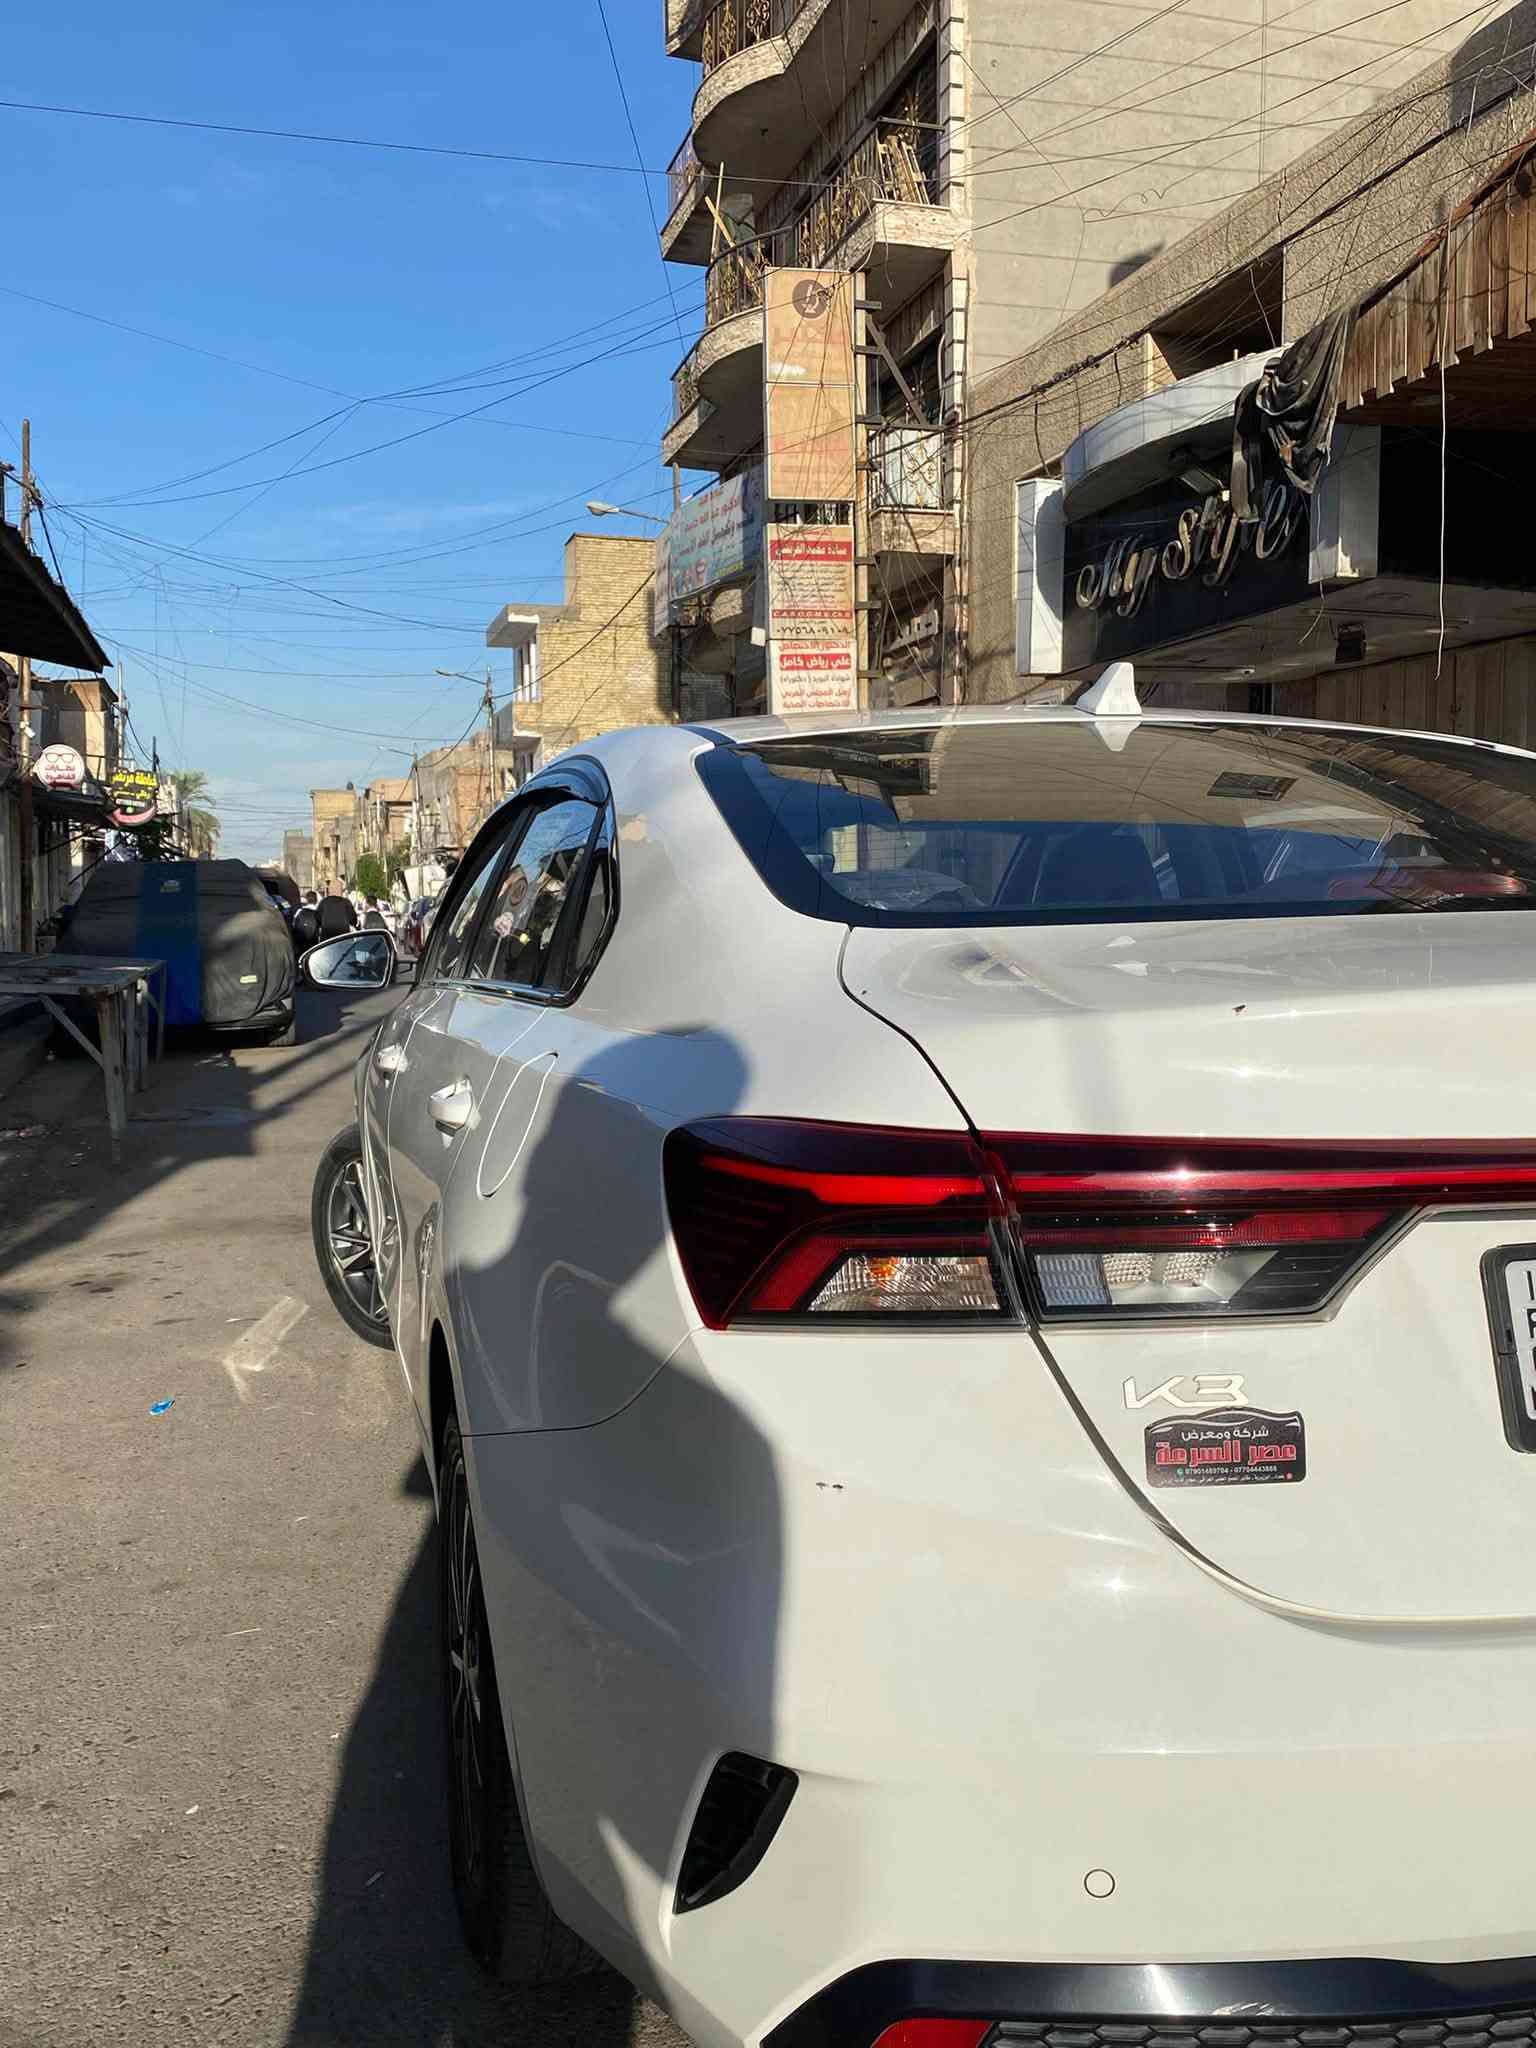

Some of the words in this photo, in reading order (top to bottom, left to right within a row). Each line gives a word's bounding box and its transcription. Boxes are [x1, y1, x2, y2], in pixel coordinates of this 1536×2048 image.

[1161, 484, 1293, 588] Stye
[782, 655, 804, 670] كامل
[806, 655, 829, 669] رياض
[831, 655, 851, 669] علي
[1122, 1374, 1250, 1410] K3
[1181, 1429, 1232, 1442] ومعرض
[1233, 1425, 1270, 1440] شركة
[1155, 1439, 1242, 1468] السرعة
[1247, 1443, 1298, 1466] عصر
